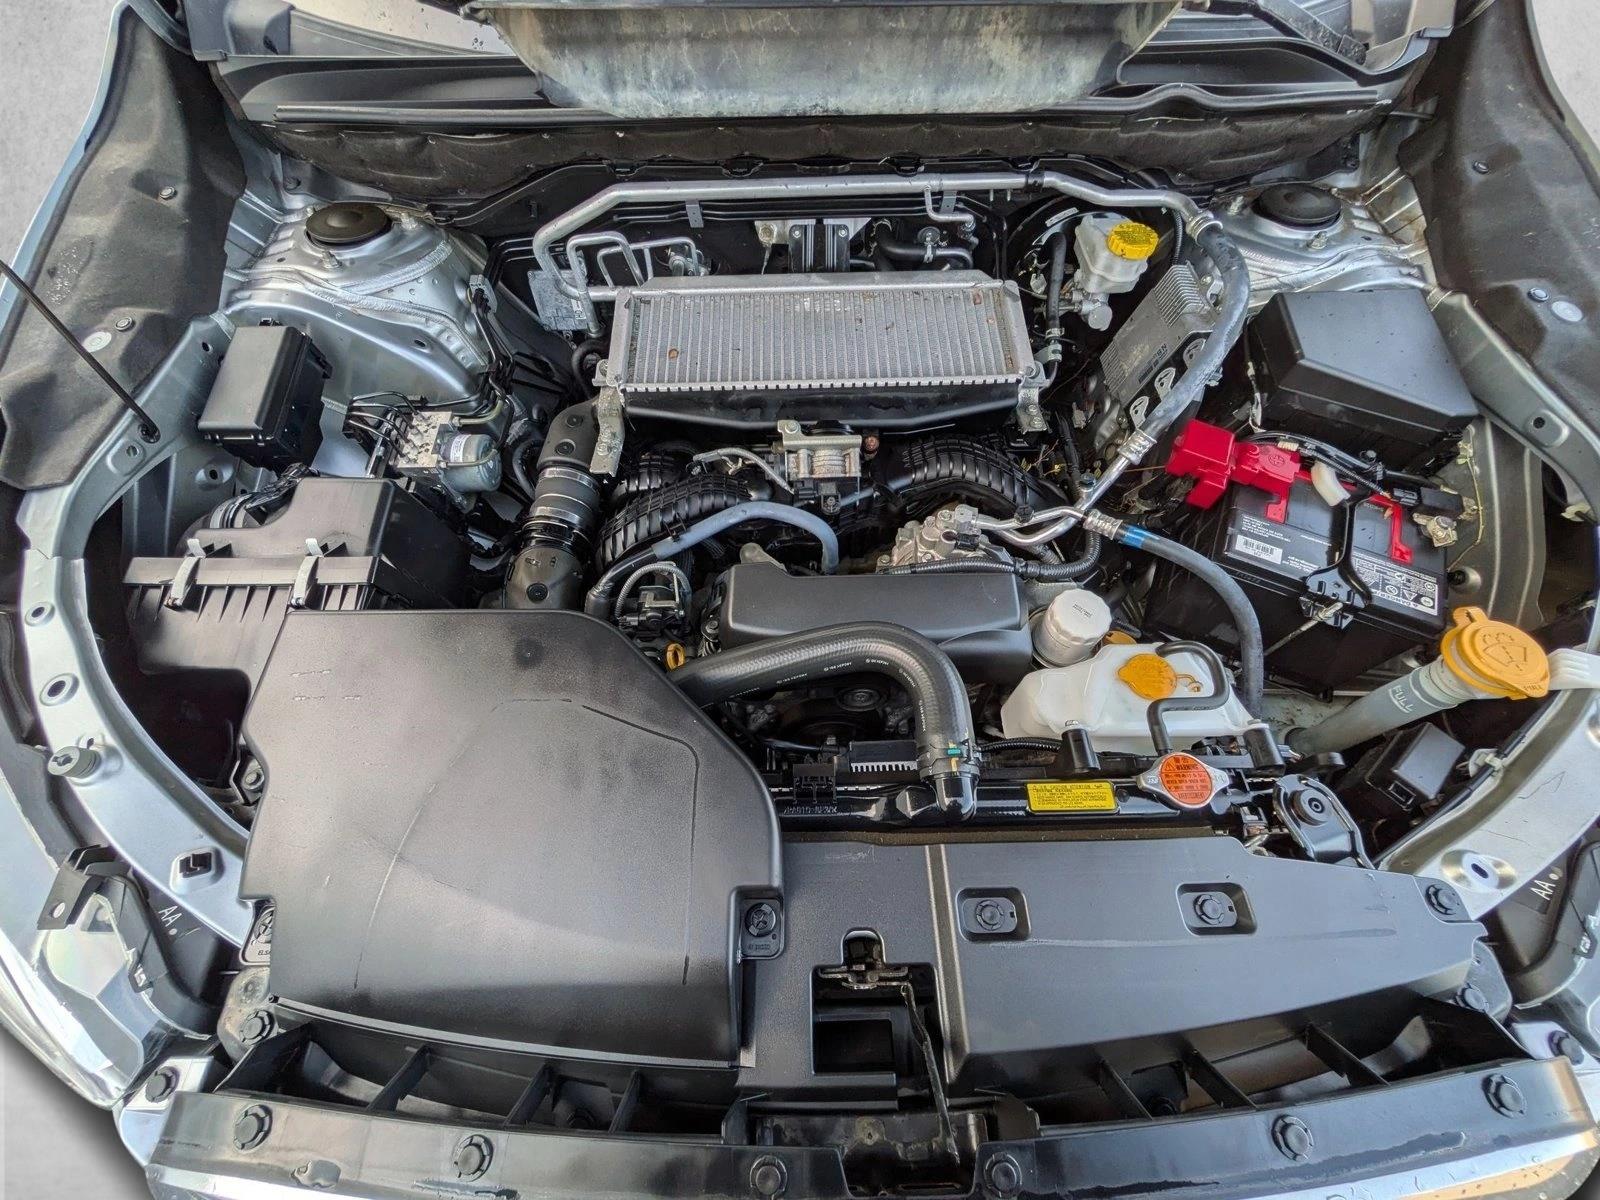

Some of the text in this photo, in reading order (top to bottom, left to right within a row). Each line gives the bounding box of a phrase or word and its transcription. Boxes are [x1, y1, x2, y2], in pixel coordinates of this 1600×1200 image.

[1394, 685, 1414, 712] FULL
[1530, 880, 1556, 900] AA
[158, 905, 182, 927] AA
